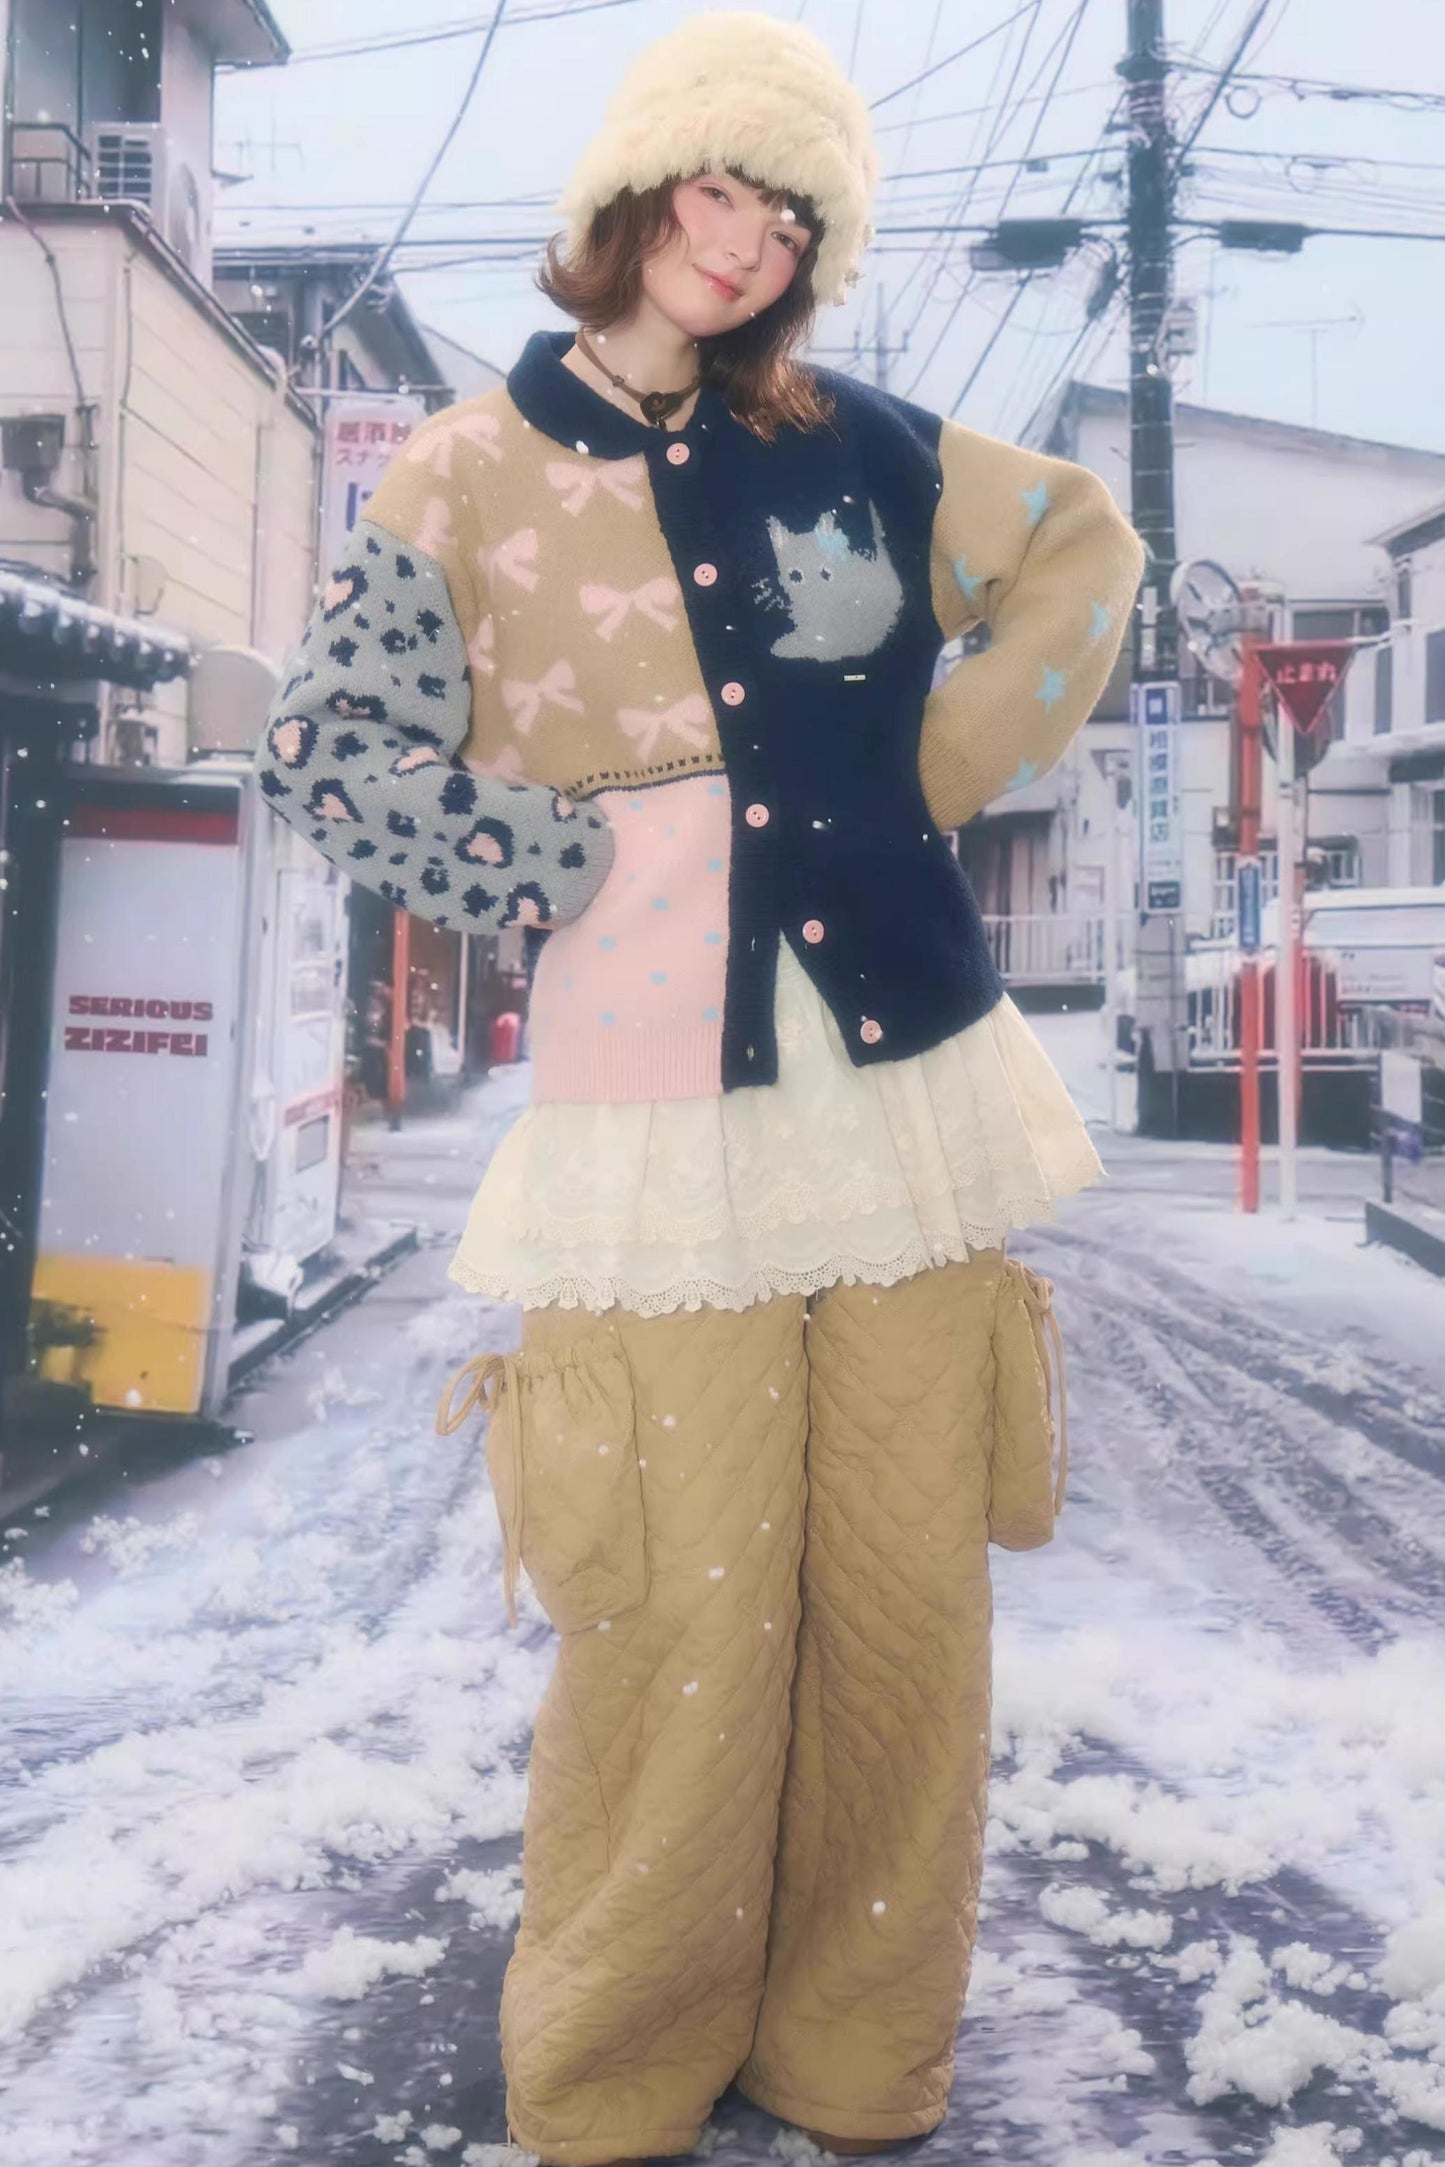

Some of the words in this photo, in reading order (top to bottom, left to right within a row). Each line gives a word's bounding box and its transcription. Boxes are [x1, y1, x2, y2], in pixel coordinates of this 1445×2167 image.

[1277, 661, 1336, 684] 止まれ
[69, 995, 213, 1021] SERIOUS
[65, 1027, 208, 1057] ZIZIFEI
